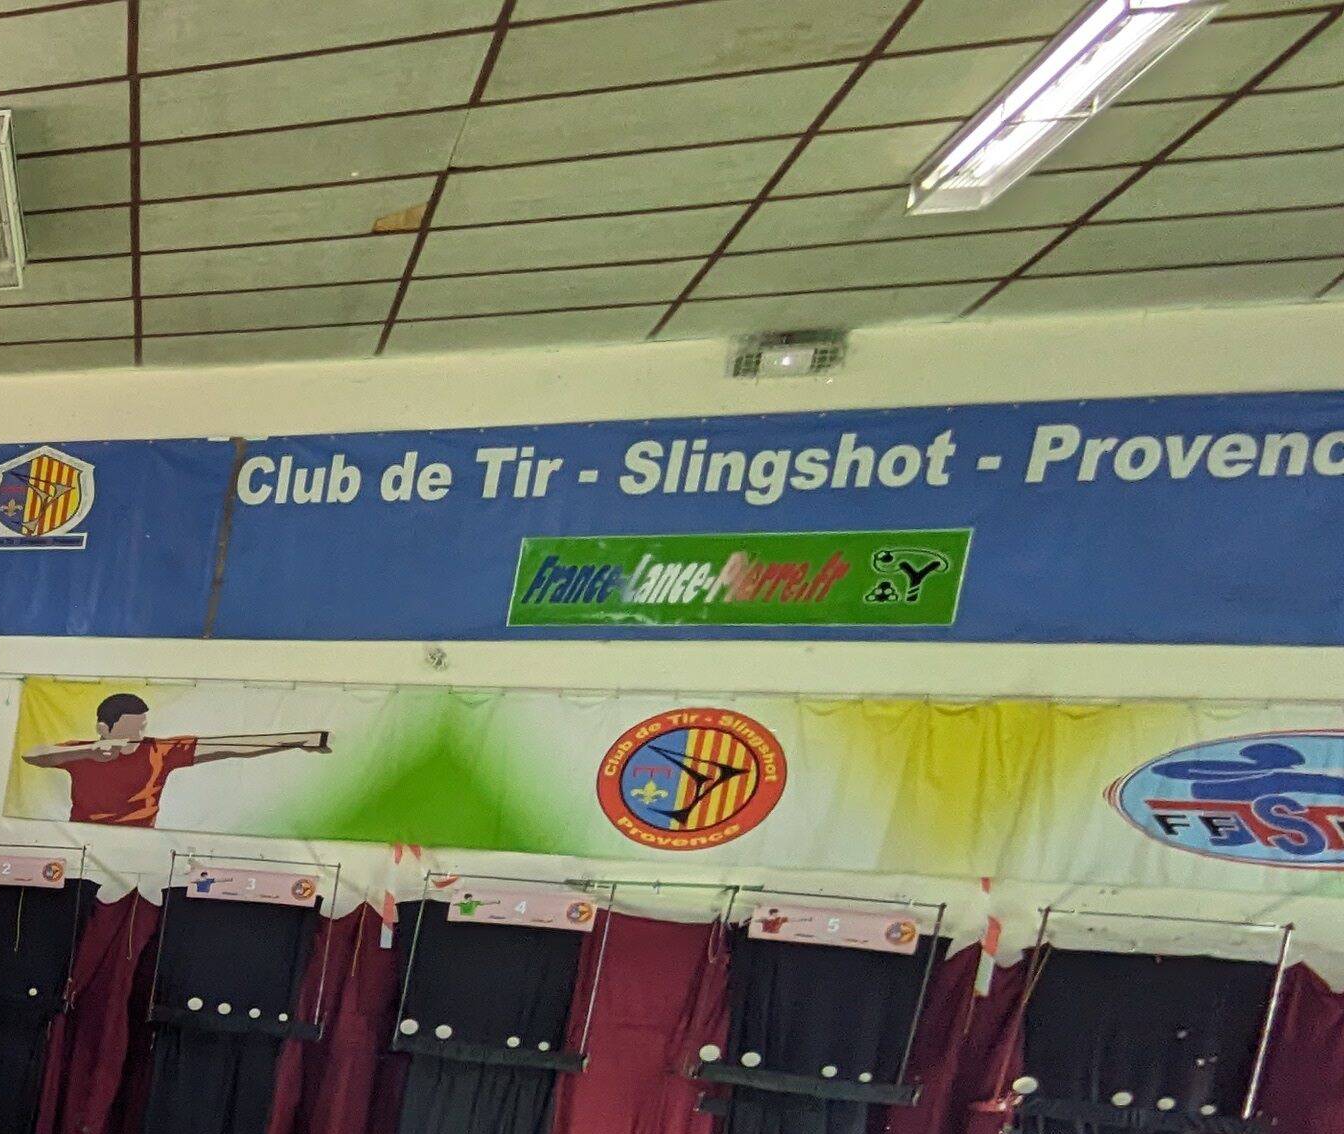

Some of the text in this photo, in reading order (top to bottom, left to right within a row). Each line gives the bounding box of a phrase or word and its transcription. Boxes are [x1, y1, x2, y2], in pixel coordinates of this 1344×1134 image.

[238, 454, 362, 505] Club
[380, 451, 452, 501] de
[475, 446, 564, 499] Tir
[577, 468, 599, 483] -
[619, 429, 957, 505] Slingshot
[976, 454, 1002, 471] -
[604, 740, 633, 777] Club
[635, 722, 662, 739] de
[666, 712, 700, 725] Tir
[718, 714, 778, 783] Slingshot
[617, 816, 741, 847] Provence
[1, 862, 12, 875] 2
[245, 878, 257, 891] 3
[514, 901, 528, 915] 4
[827, 917, 840, 933] 5
